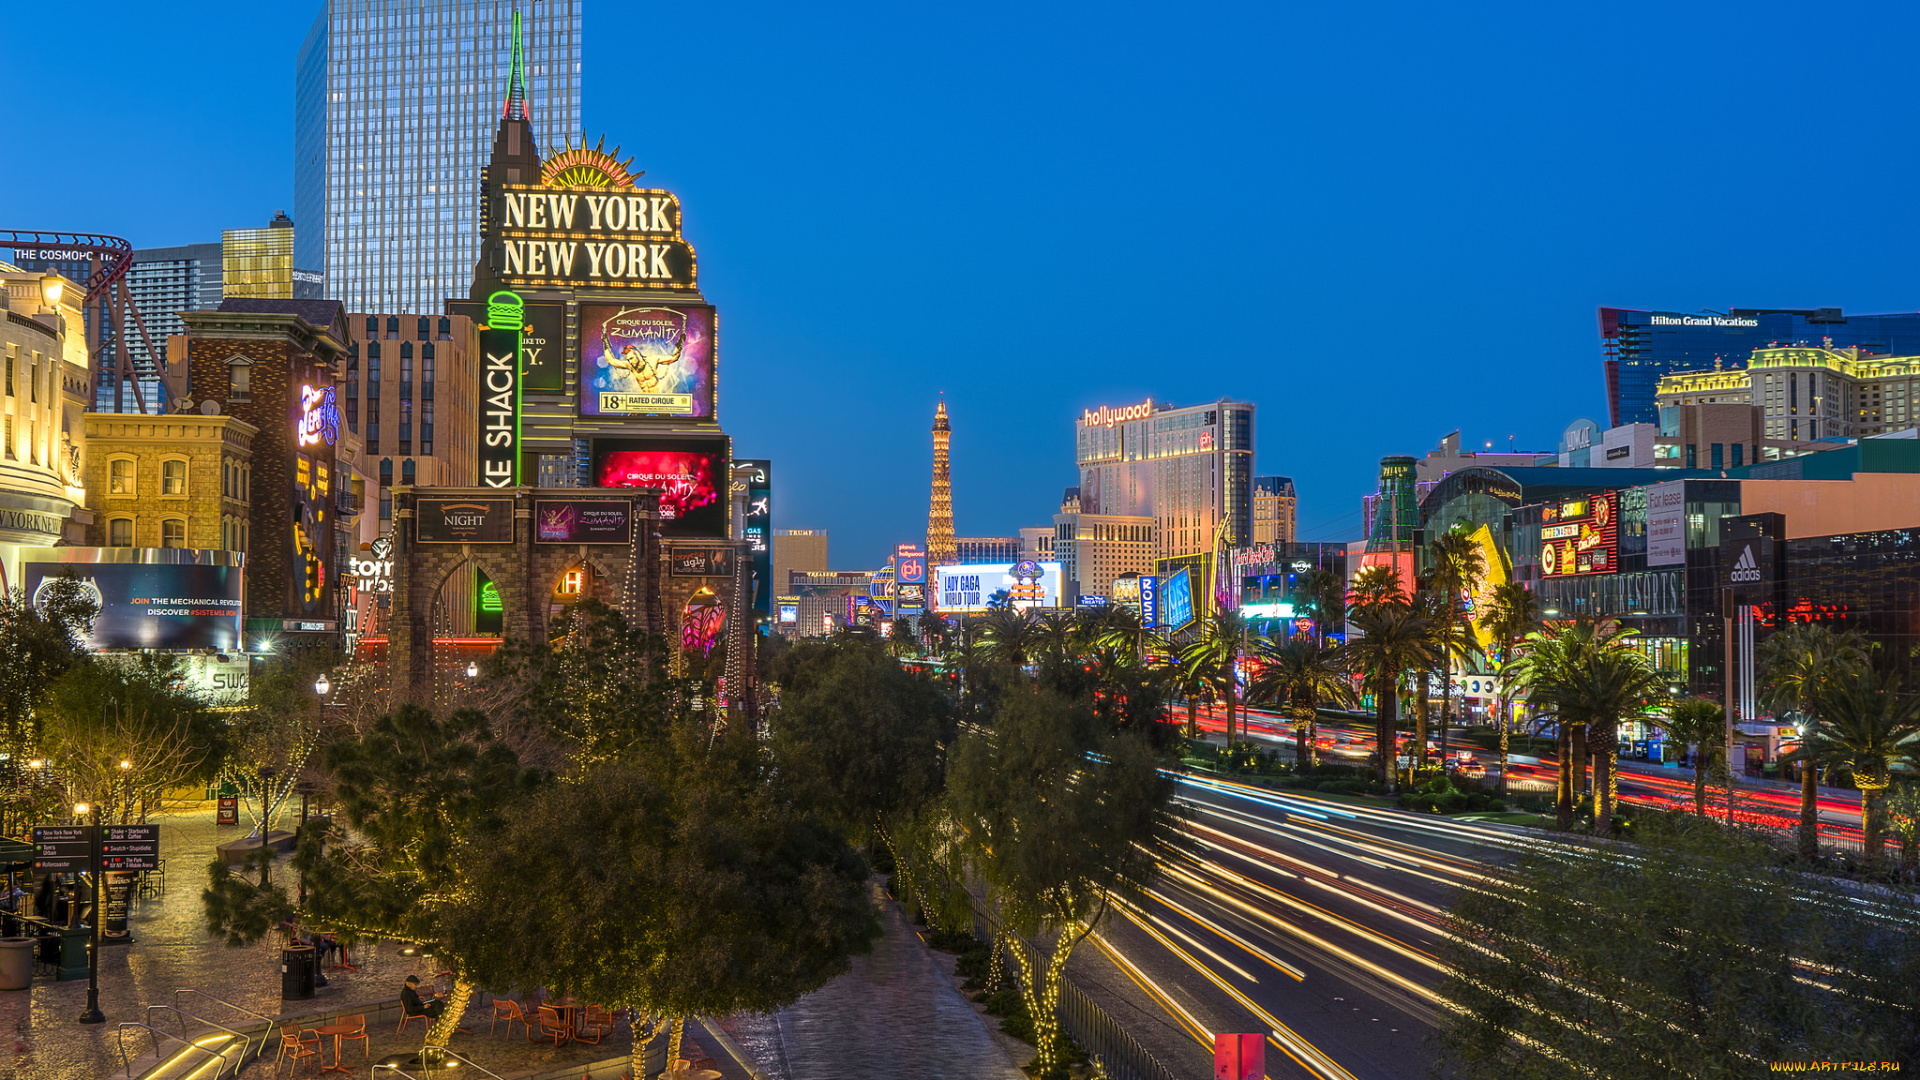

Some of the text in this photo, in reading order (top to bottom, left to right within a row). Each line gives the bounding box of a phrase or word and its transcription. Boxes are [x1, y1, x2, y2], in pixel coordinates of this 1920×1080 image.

[504, 192, 672, 232] NEW YORK
[15, 249, 37, 260] THE
[503, 240, 672, 279] NEW YORK
[617, 319, 640, 327] CIRQUE
[1651, 315, 1758, 328] Hilton Grand Vacations
[535, 337, 546, 345] TO
[611, 326, 680, 344] ZUMANITY
[486, 352, 513, 448] SHACK
[603, 396, 625, 409] 18+
[651, 397, 675, 405] CIRQUE
[1085, 398, 1151, 428] hollywood
[627, 473, 653, 481] CIRQUE
[1650, 489, 1682, 508] For lease
[1561, 500, 1588, 518] SUBWAY
[9, 511, 41, 530] YORK
[444, 515, 485, 526] NIGHT
[579, 515, 627, 528] ZUMANITY
[683, 556, 706, 567] ugly
[1248, 546, 1261, 567] Rock
[904, 560, 922, 577] ph
[1731, 568, 1760, 581] adidas
[945, 575, 980, 592] LADY GAGA
[170, 598, 219, 606] MECHANICAL
[945, 591, 980, 606] WORLD TOUR
[1619, 573, 1677, 616] RESORTS
